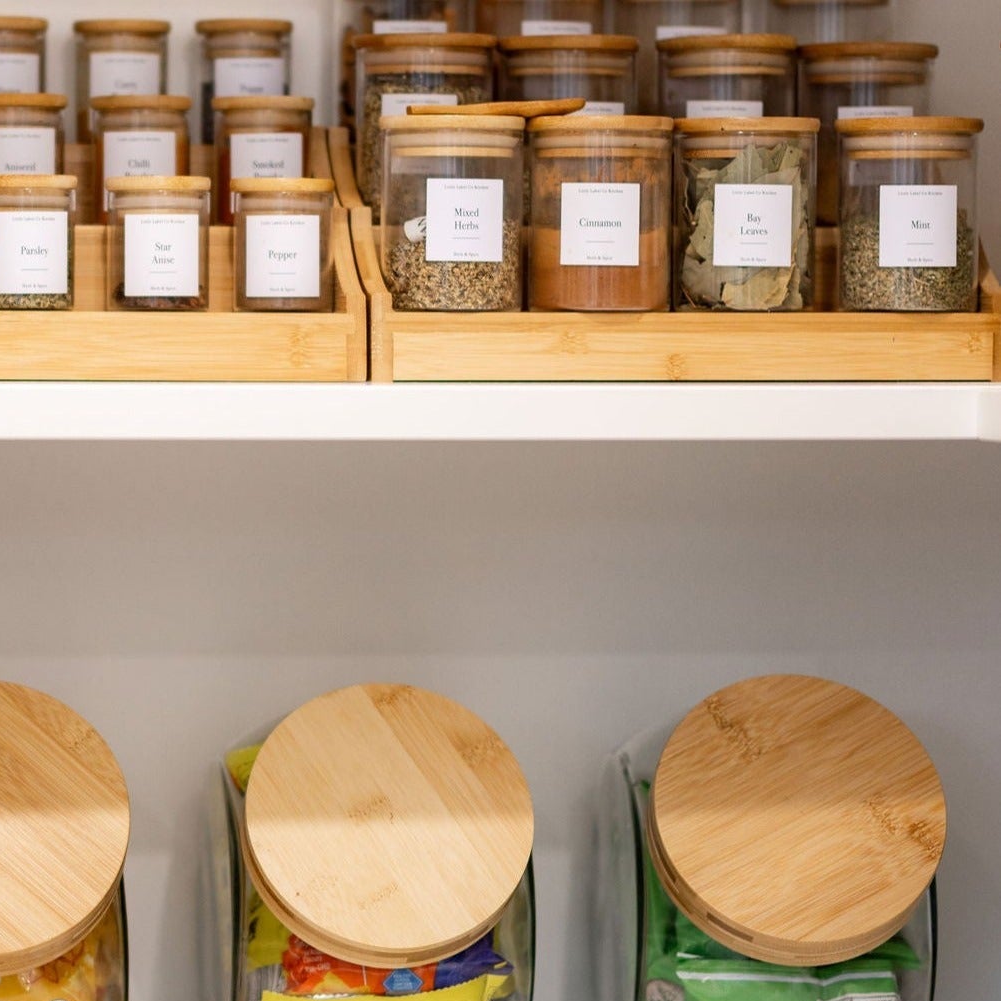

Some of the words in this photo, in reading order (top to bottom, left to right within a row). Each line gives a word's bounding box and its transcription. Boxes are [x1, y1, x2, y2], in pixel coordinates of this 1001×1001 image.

[128, 158, 151, 168] Chilli
[253, 160, 285, 170] Smoked
[455, 208, 479, 218] Mixed
[579, 218, 622, 228] Cinnamon
[747, 213, 761, 226] Bay
[455, 220, 479, 230] Herbs
[911, 220, 931, 230] Mint
[740, 226, 768, 236] Leaves
[21, 246, 49, 257] Parsley
[155, 242, 171, 252] Star
[151, 256, 175, 264] Anise
[268, 250, 297, 262] Pepper
